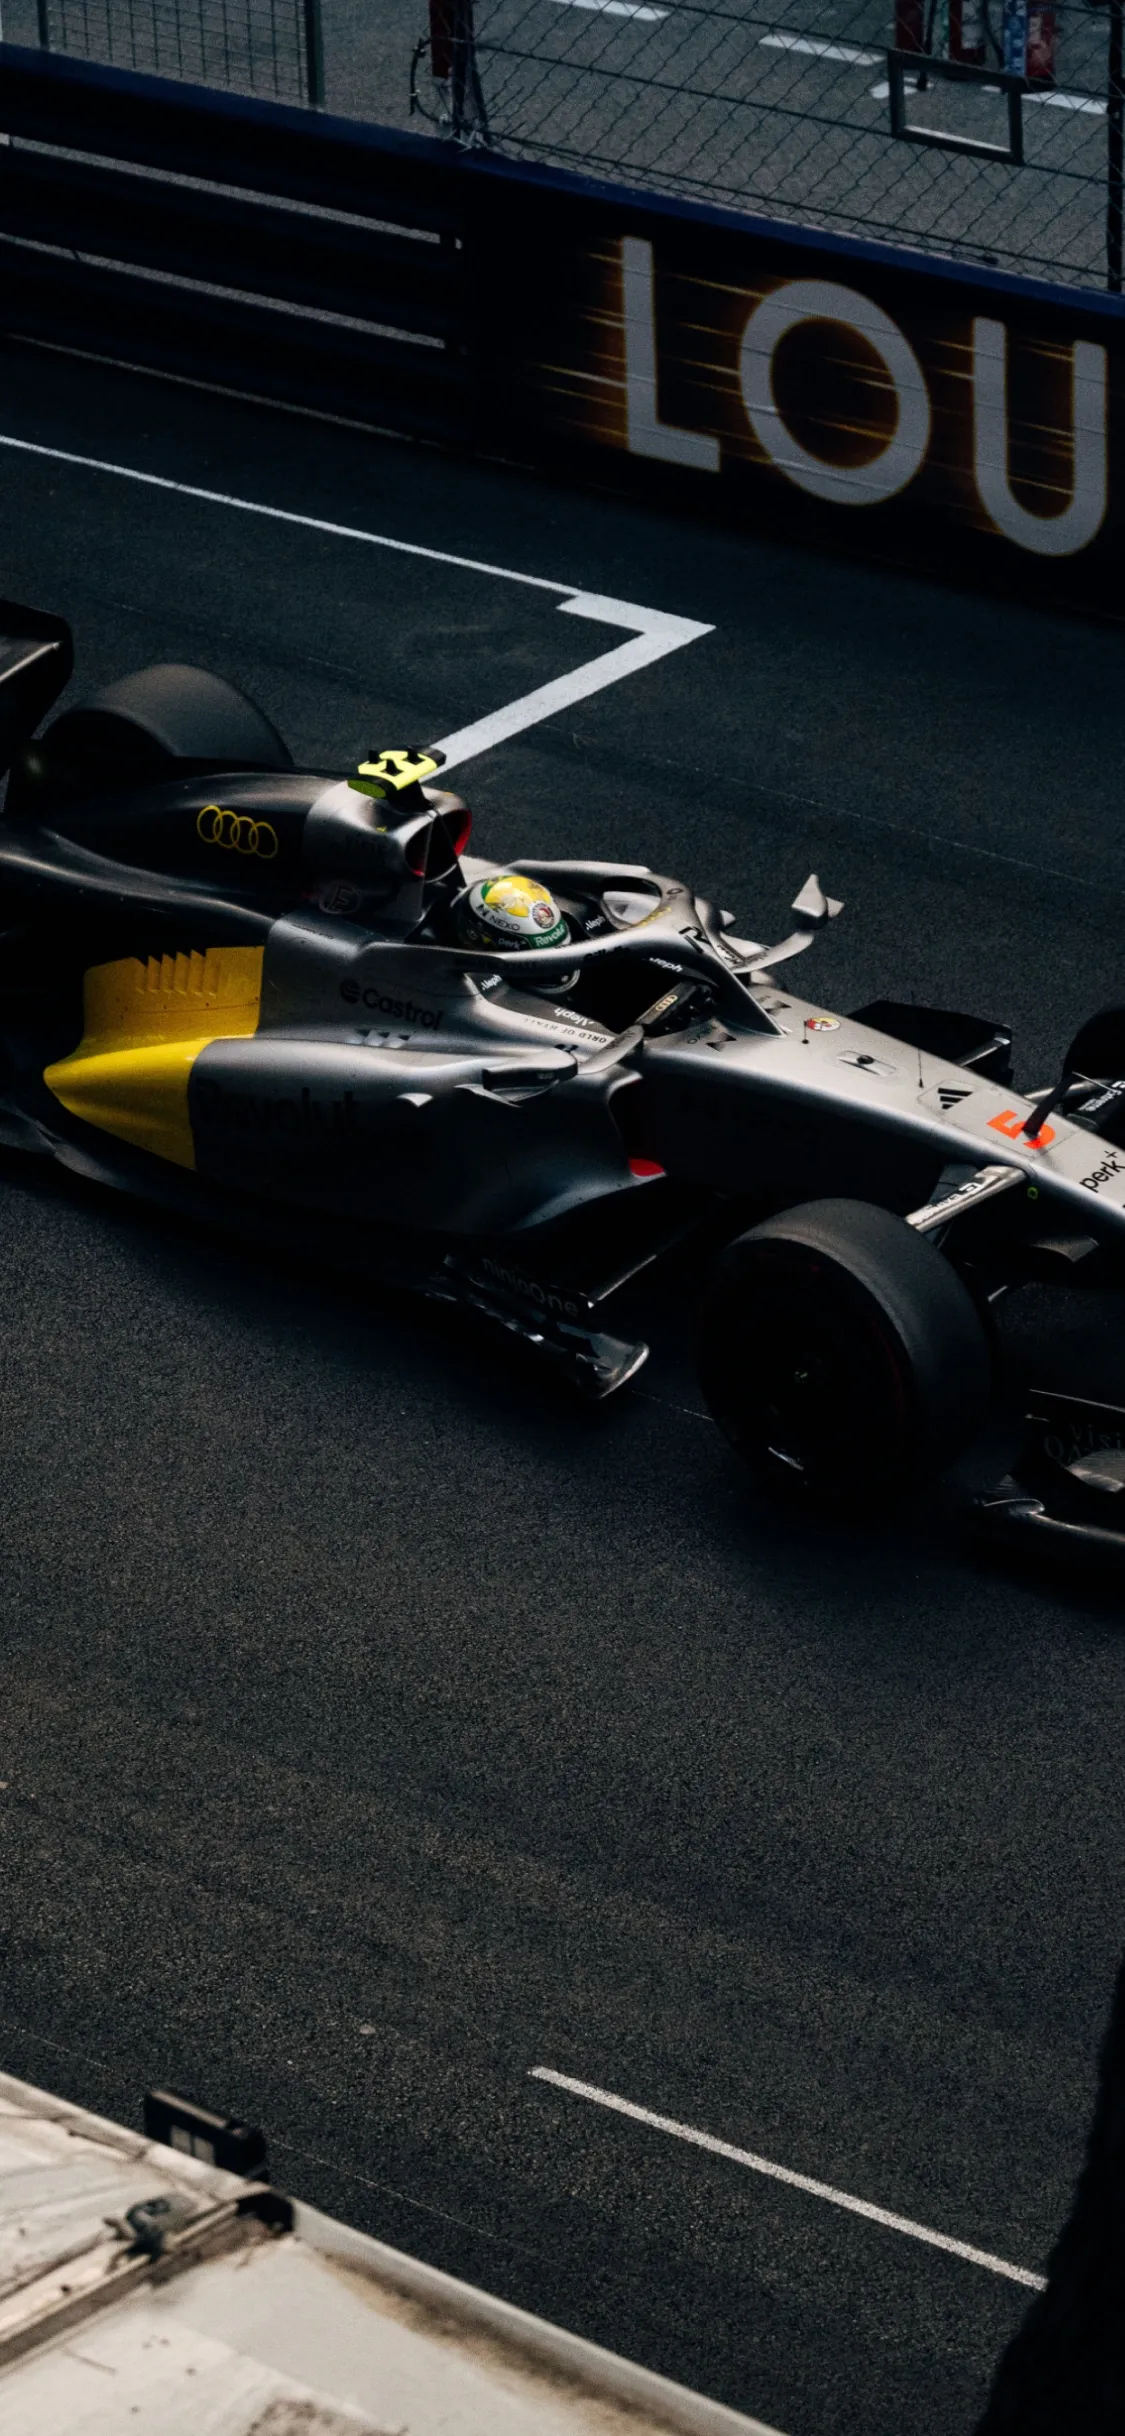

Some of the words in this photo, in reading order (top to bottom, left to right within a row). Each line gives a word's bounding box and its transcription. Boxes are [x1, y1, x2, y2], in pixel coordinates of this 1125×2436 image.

[620, 234, 1108, 557] LOU
[490, 914, 520, 931] NEXO
[362, 988, 443, 1031] Castrol
[553, 1006, 596, 1026] Aleph
[578, 1031, 608, 1043] ORLD
[986, 1109, 1056, 1150] 5
